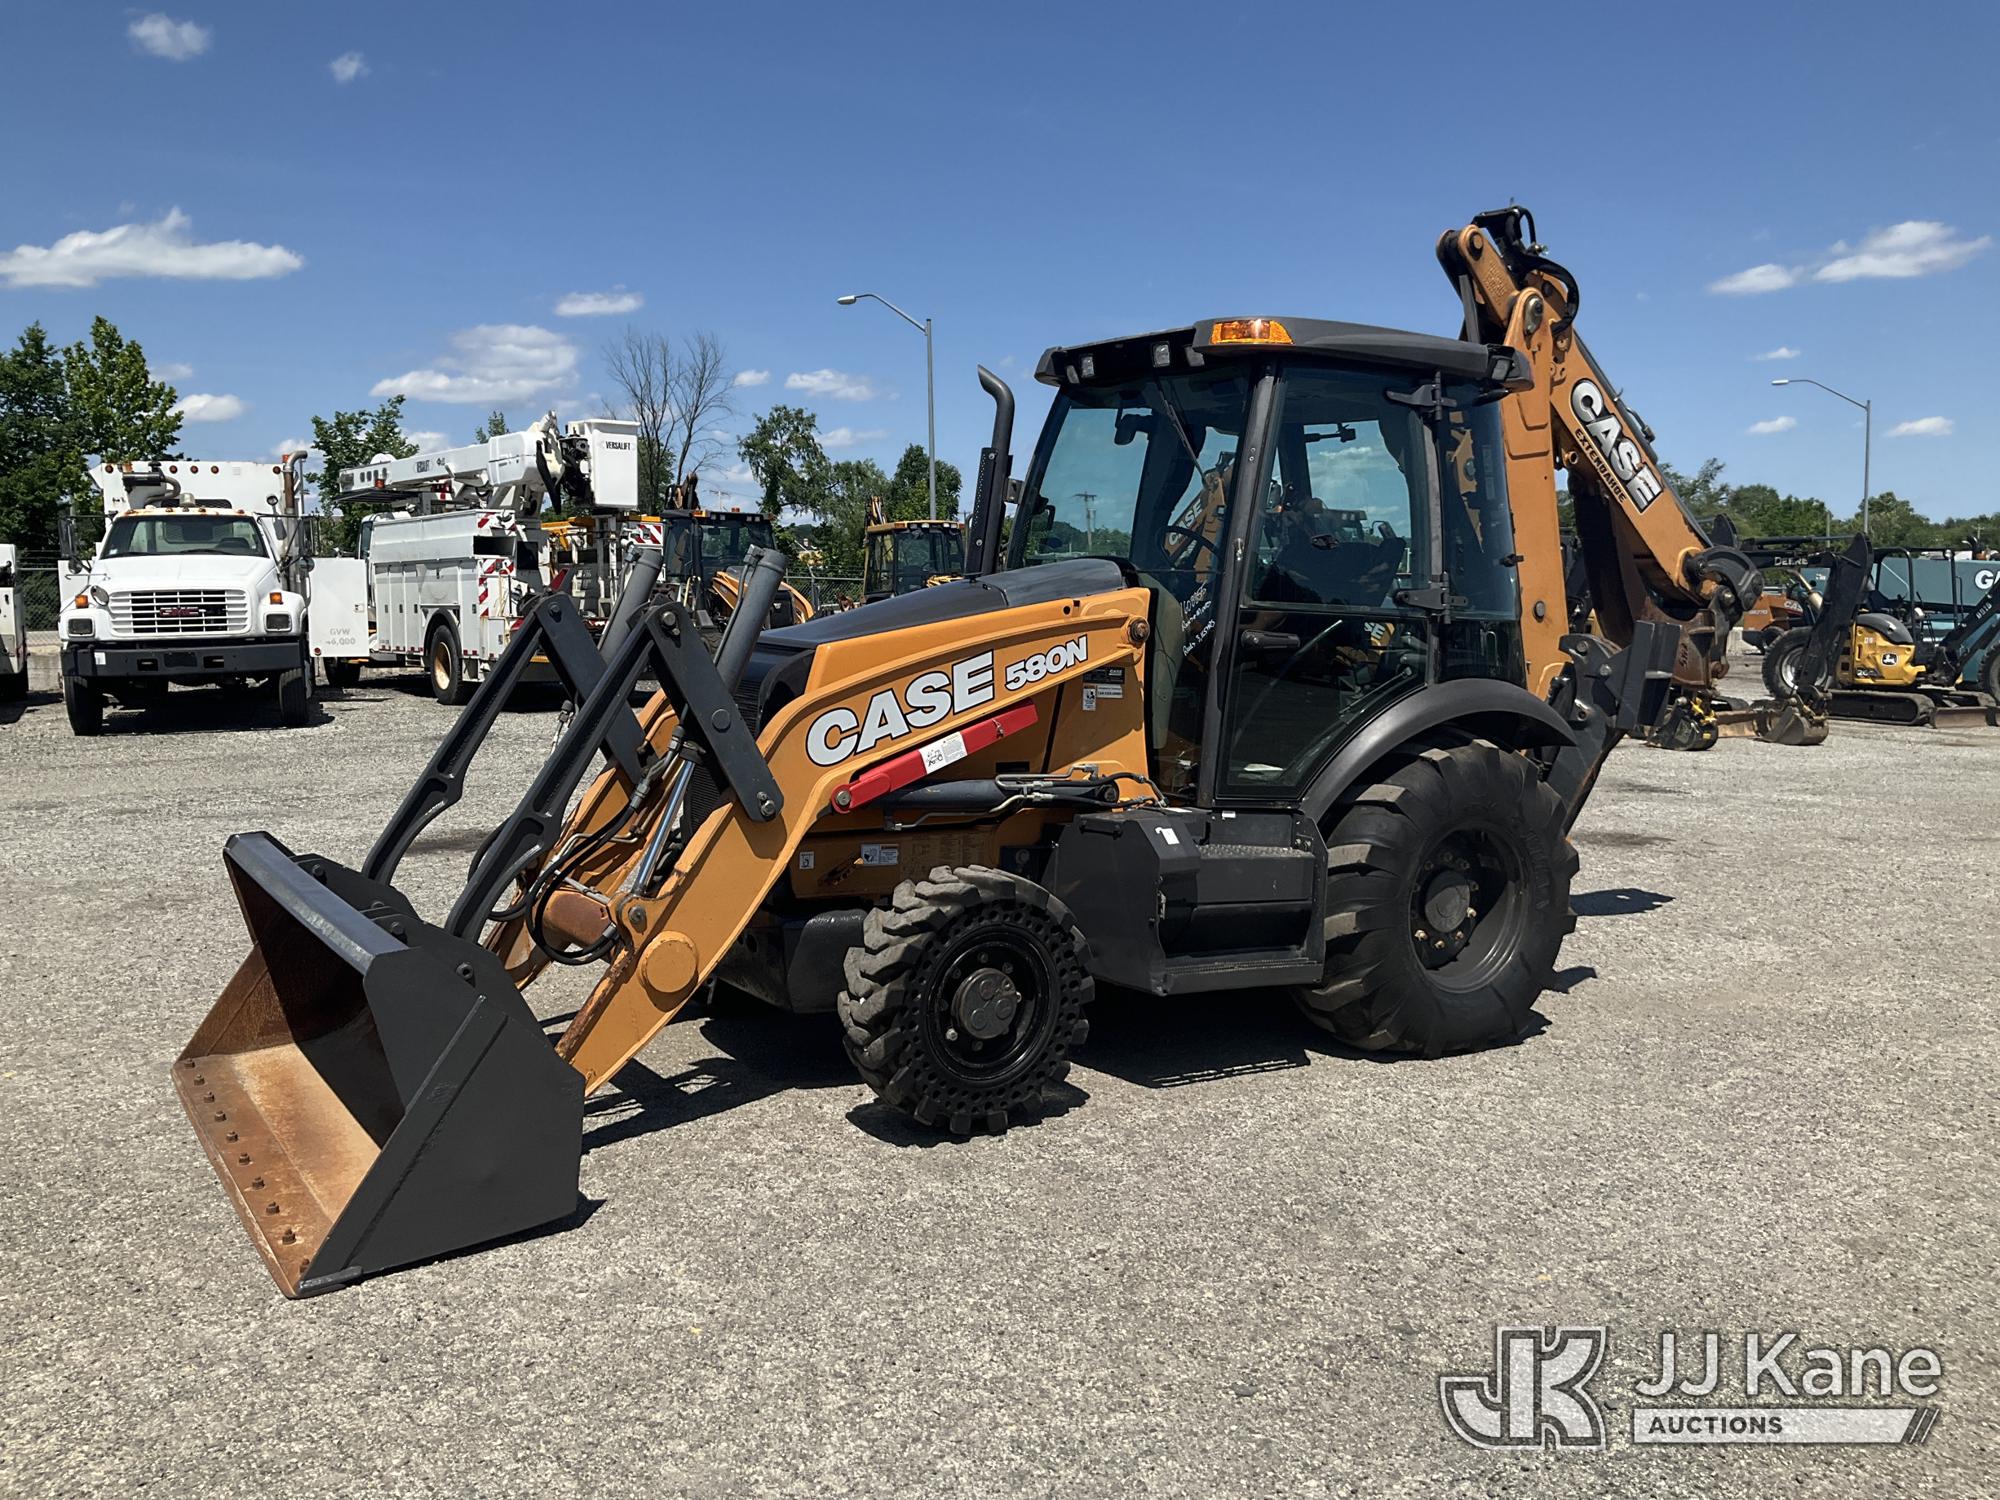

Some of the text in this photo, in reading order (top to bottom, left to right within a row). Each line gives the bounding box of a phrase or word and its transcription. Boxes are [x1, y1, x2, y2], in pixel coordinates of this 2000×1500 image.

[605, 440, 631, 450] VERSALIFT
[1571, 378, 1664, 513] CASE
[1575, 428, 1627, 503] EXTENDAHOE
[329, 628, 351, 636] GVW
[805, 634, 1088, 767] CASE 580N
